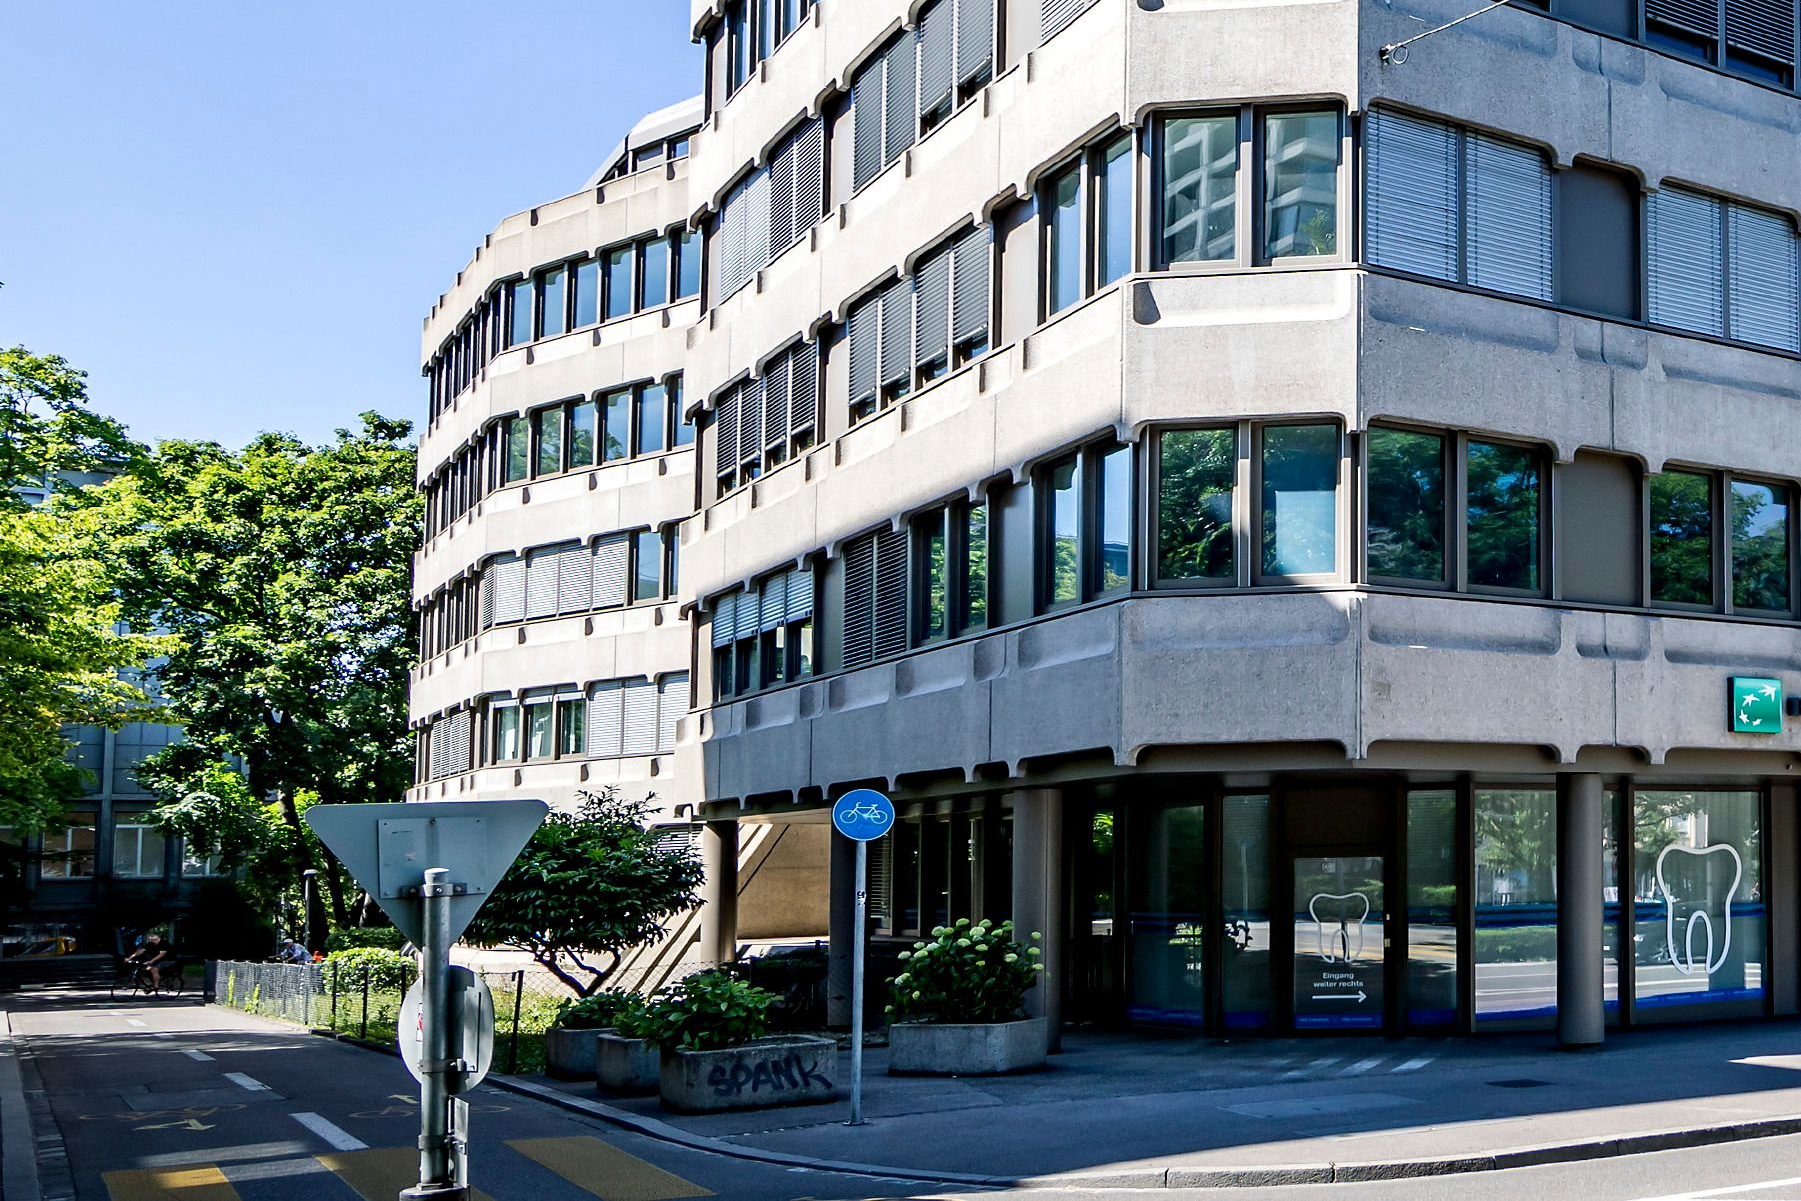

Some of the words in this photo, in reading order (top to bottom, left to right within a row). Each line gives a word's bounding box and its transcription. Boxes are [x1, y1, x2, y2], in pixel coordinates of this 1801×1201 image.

[1322, 972, 1354, 980] Eingang
[1313, 980, 1337, 988] weiter
[1339, 980, 1364, 988] rechts
